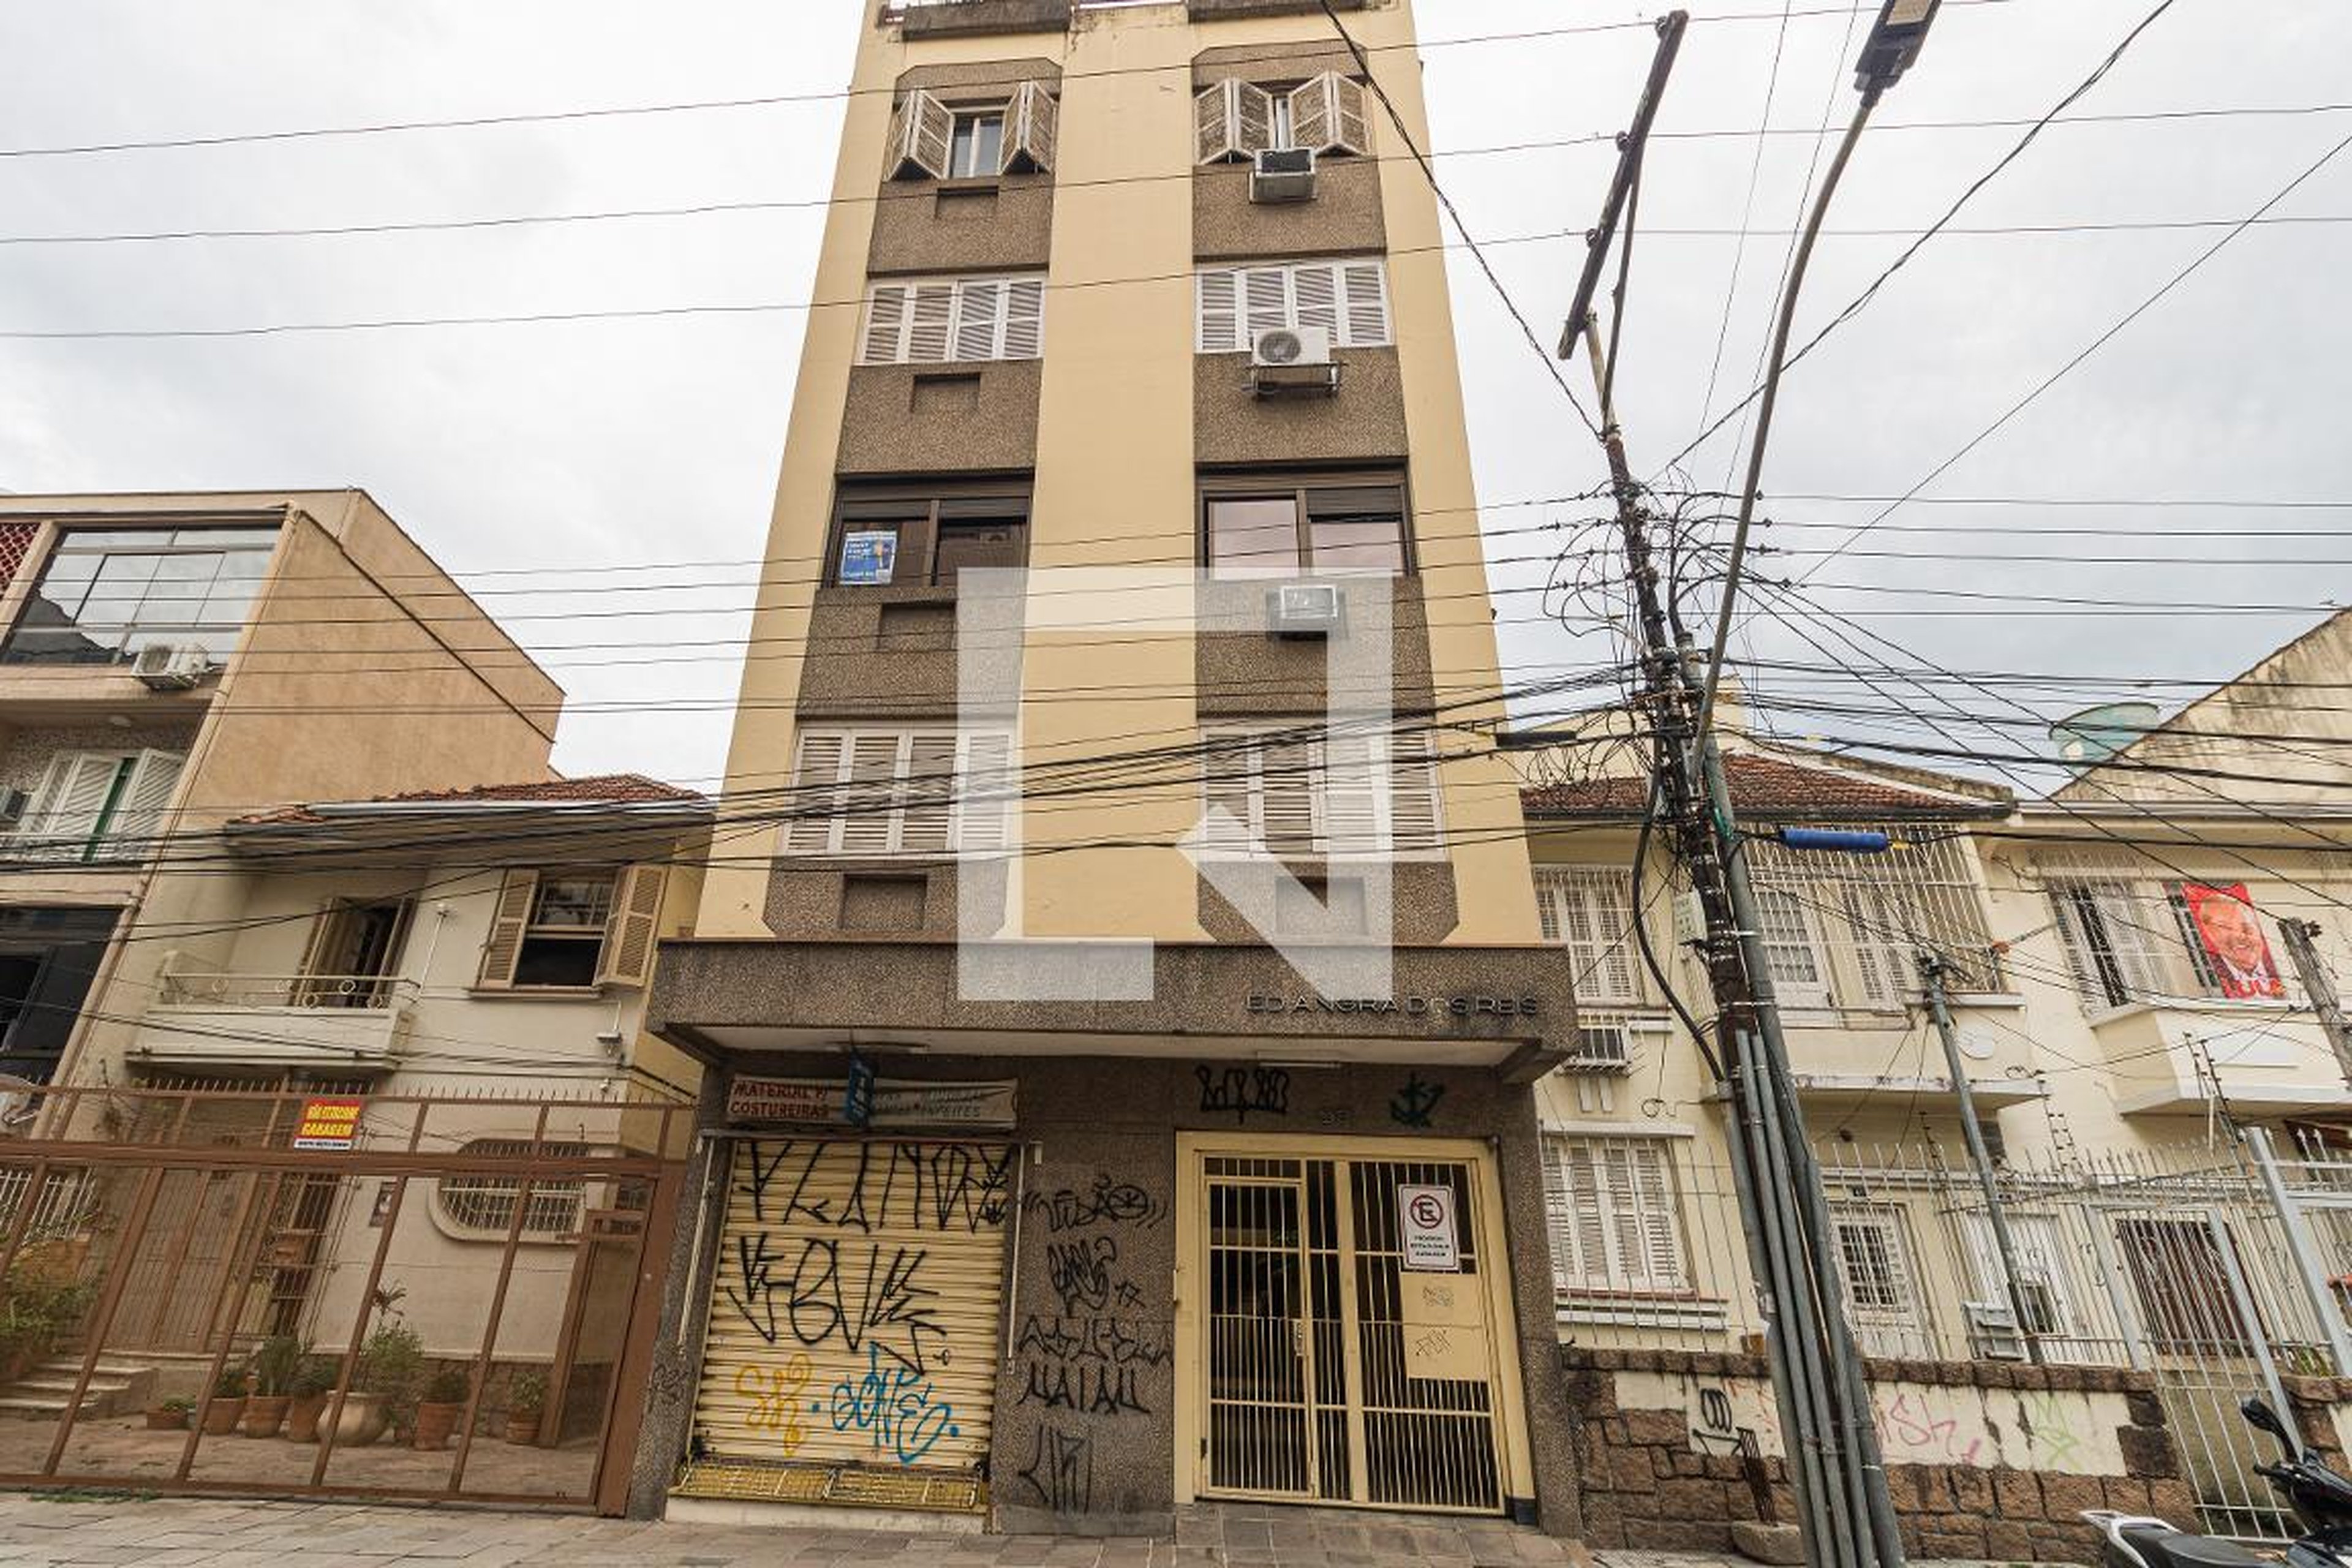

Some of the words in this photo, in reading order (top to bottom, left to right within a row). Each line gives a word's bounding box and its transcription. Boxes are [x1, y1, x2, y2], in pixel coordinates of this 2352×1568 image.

[1247, 995, 1285, 1012] ED
[1291, 995, 1400, 1013] ANGRA
[1475, 996, 1537, 1014] REIS
